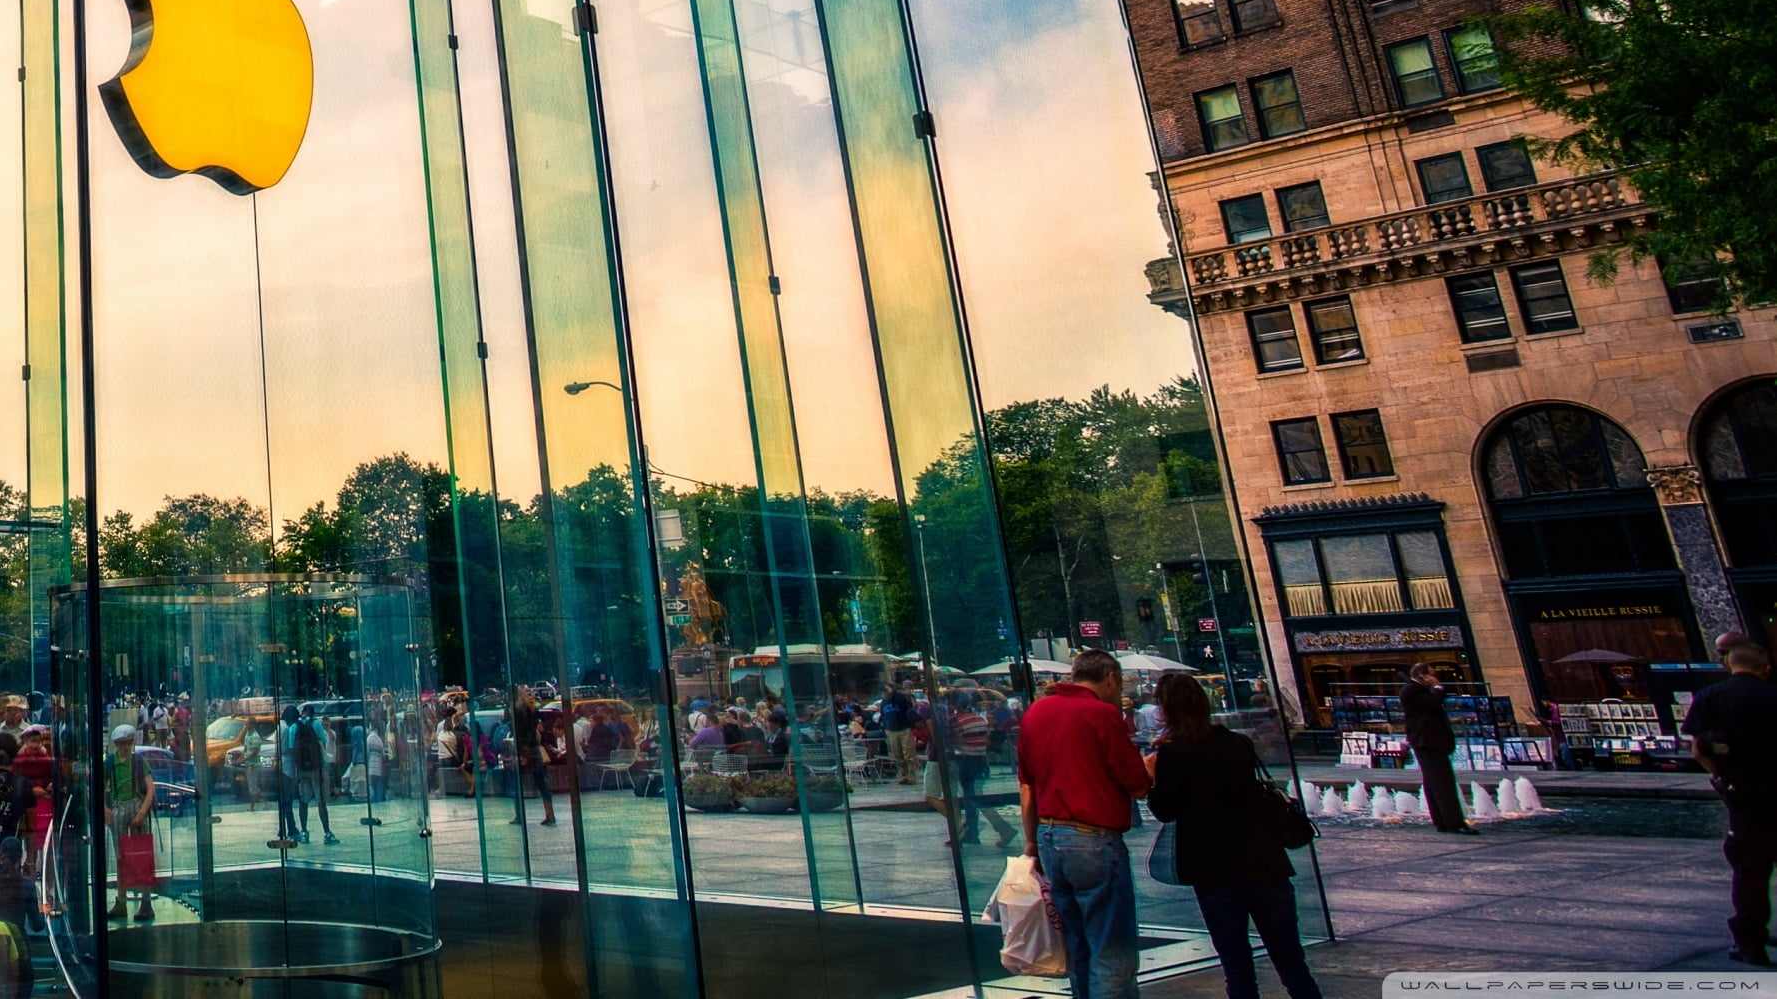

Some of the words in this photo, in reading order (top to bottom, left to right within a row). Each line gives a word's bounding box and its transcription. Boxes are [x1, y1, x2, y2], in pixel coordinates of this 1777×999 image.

[1540, 610, 1549, 619] A
[1551, 609, 1566, 618] LA
[1569, 607, 1617, 617] VIEILLE
[1620, 605, 1662, 616] RUSSIE
[1306, 636, 1315, 646] A
[1318, 635, 1336, 646] LA
[1338, 633, 1390, 645] VIEILLE
[1402, 631, 1450, 642] RUSSIE
